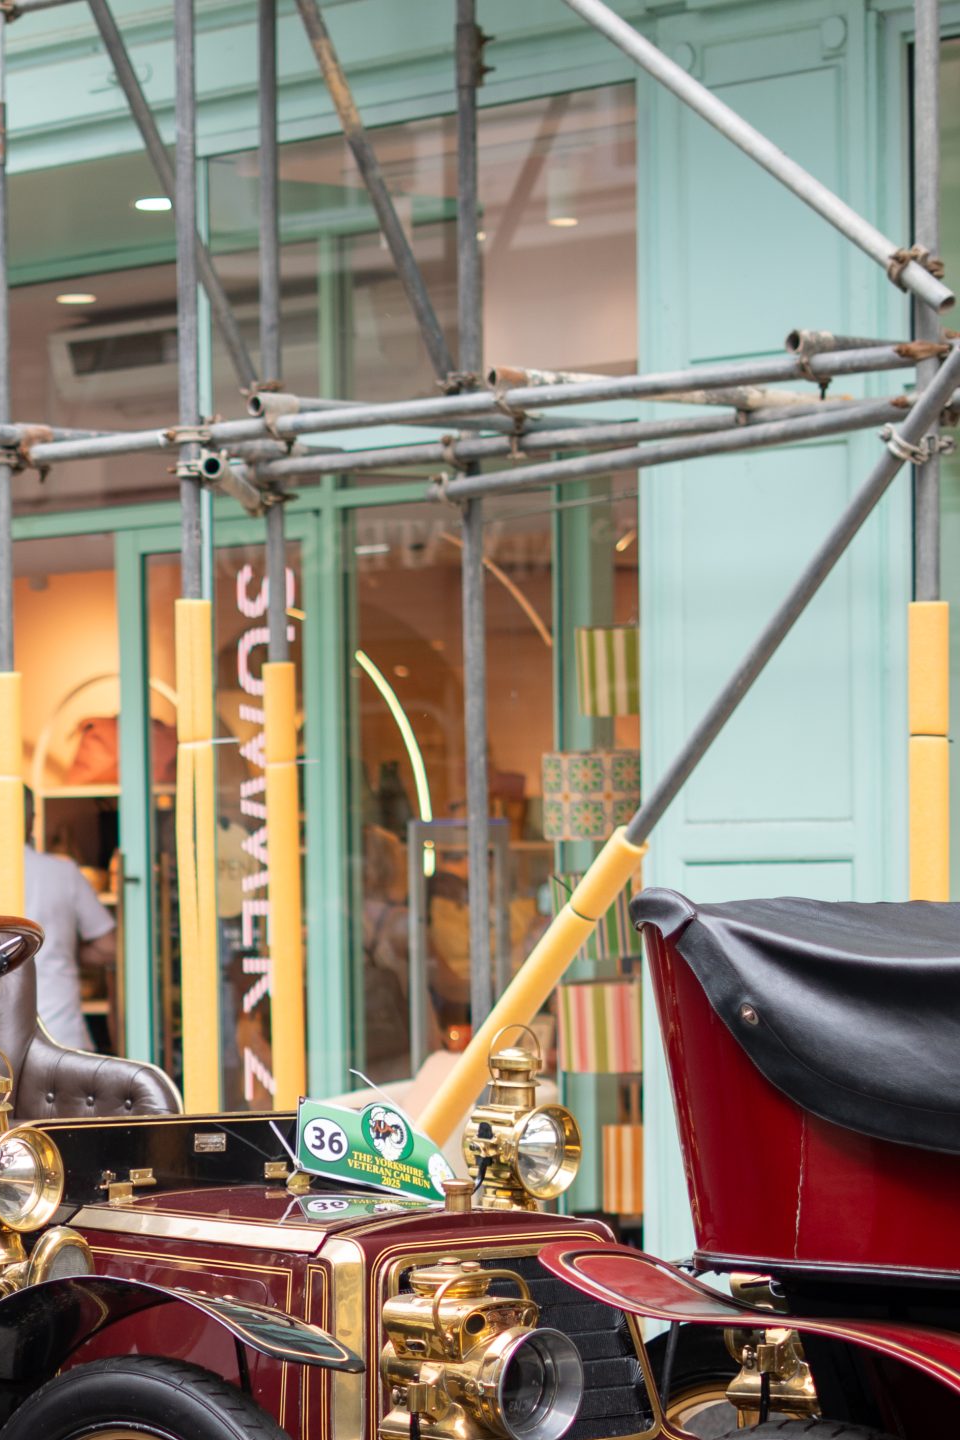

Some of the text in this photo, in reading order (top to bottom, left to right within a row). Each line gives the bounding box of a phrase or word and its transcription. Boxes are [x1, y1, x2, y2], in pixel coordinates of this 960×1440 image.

[311, 1126, 343, 1154] 36
[347, 1158, 431, 1189] VETERAN CAR RUN
[352, 1150, 425, 1178] THE YORKSHIRE
[381, 1176, 401, 1188] 2025
